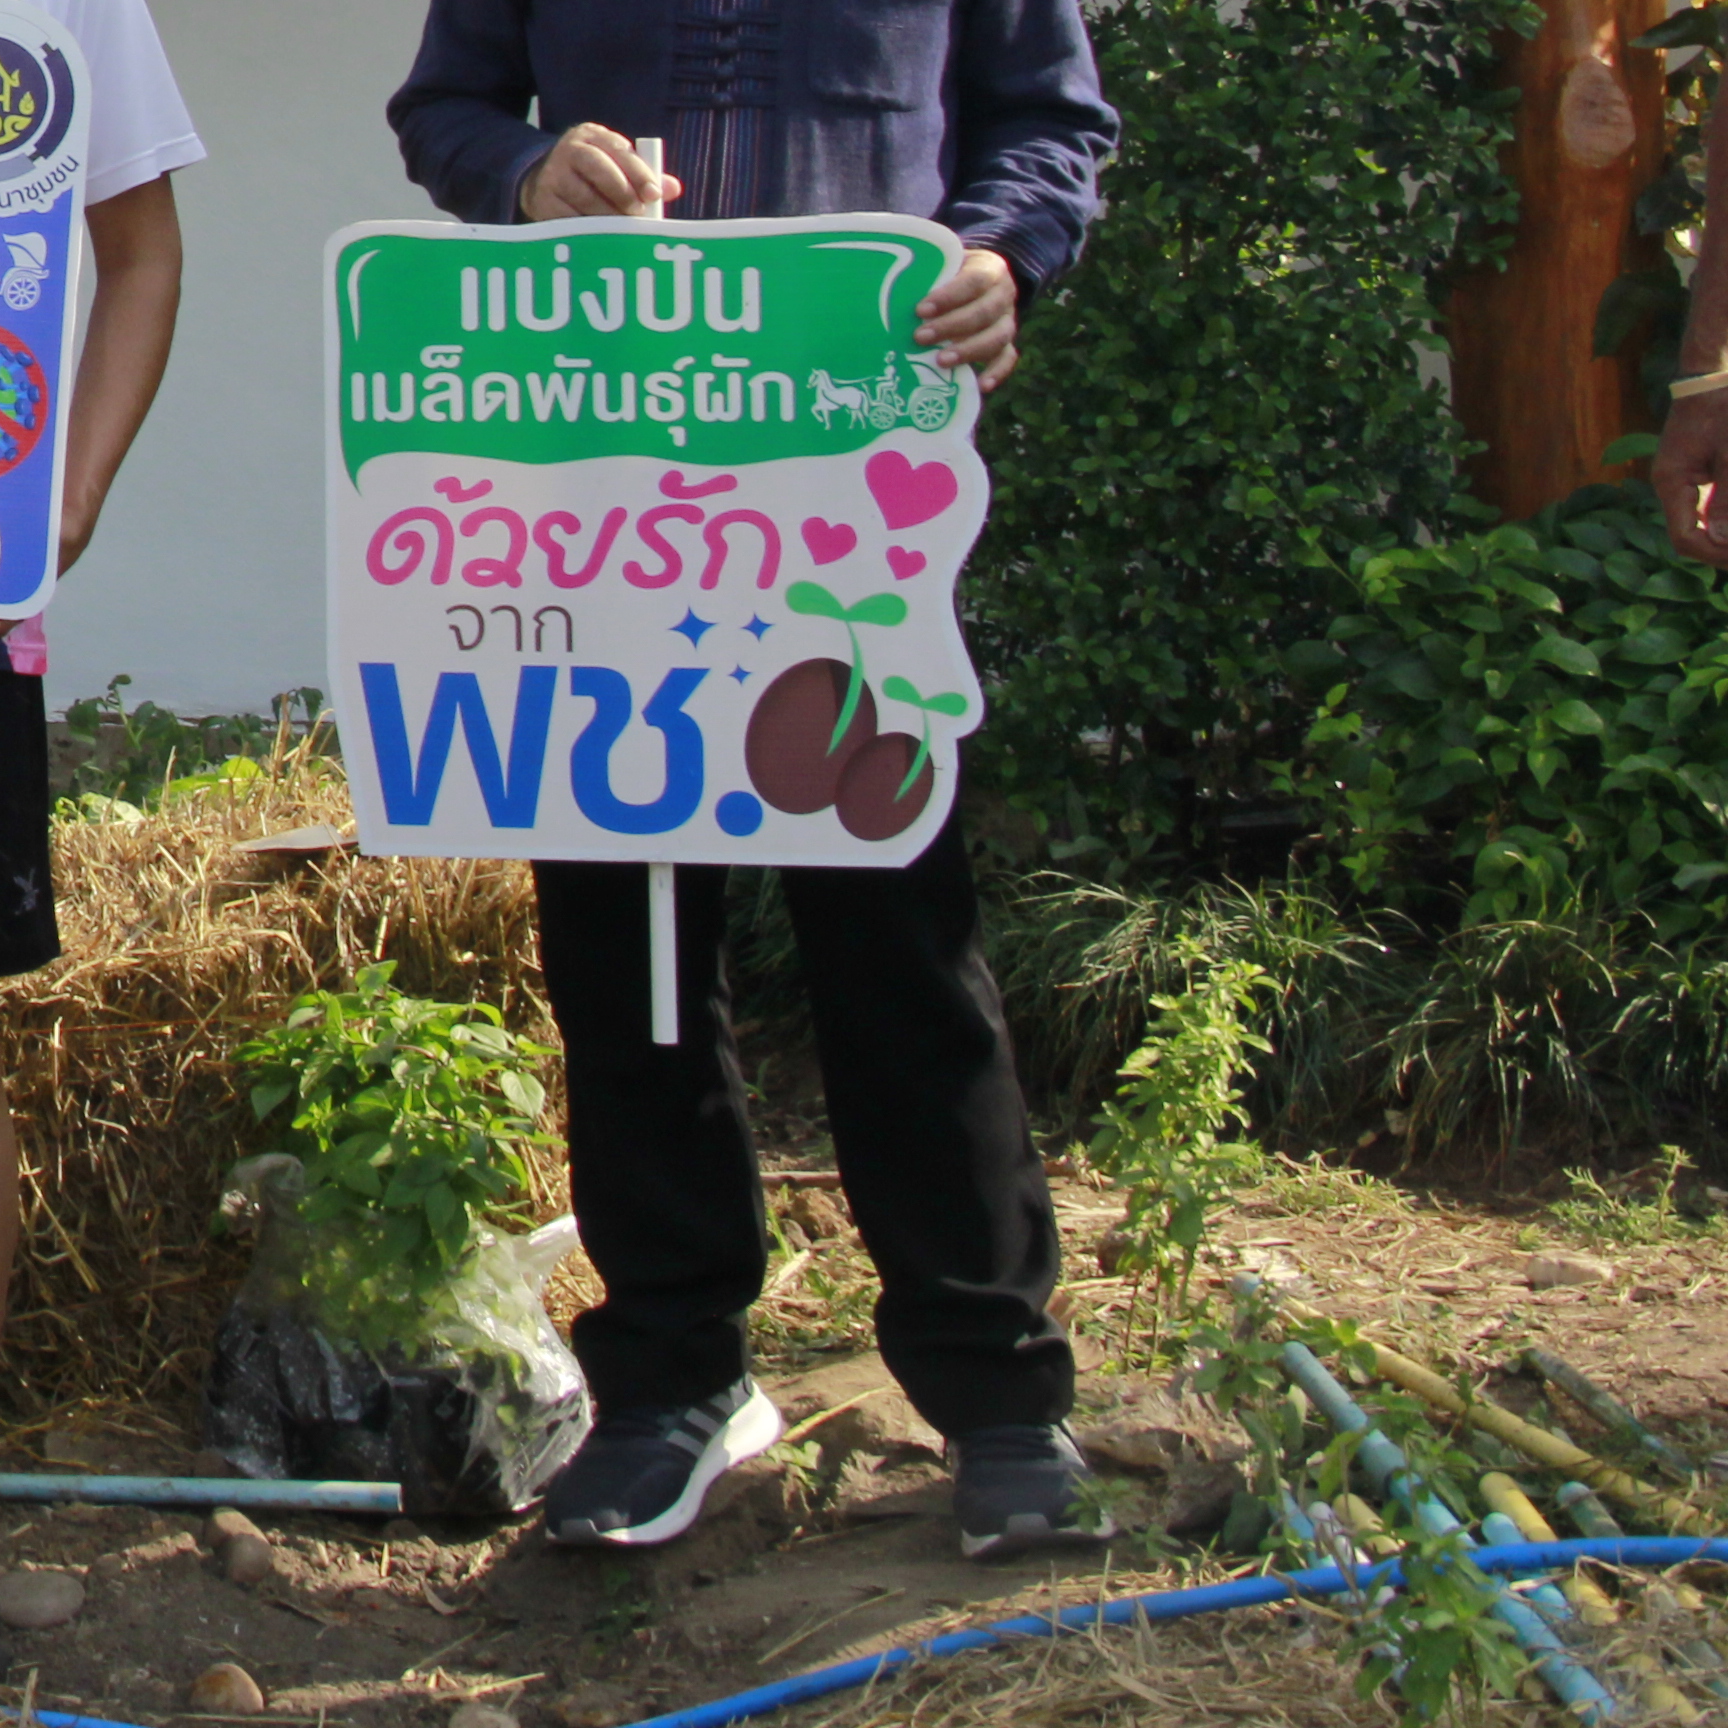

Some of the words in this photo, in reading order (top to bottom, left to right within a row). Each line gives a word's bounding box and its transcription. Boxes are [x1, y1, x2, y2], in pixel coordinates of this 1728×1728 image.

[460, 243, 763, 333] แบ่งปัน
[351, 344, 797, 447] เมล็ดพันธุ์ผัก
[366, 470, 782, 590] ด้วยรัก
[446, 604, 574, 653] จาก
[358, 661, 764, 838] พช.
